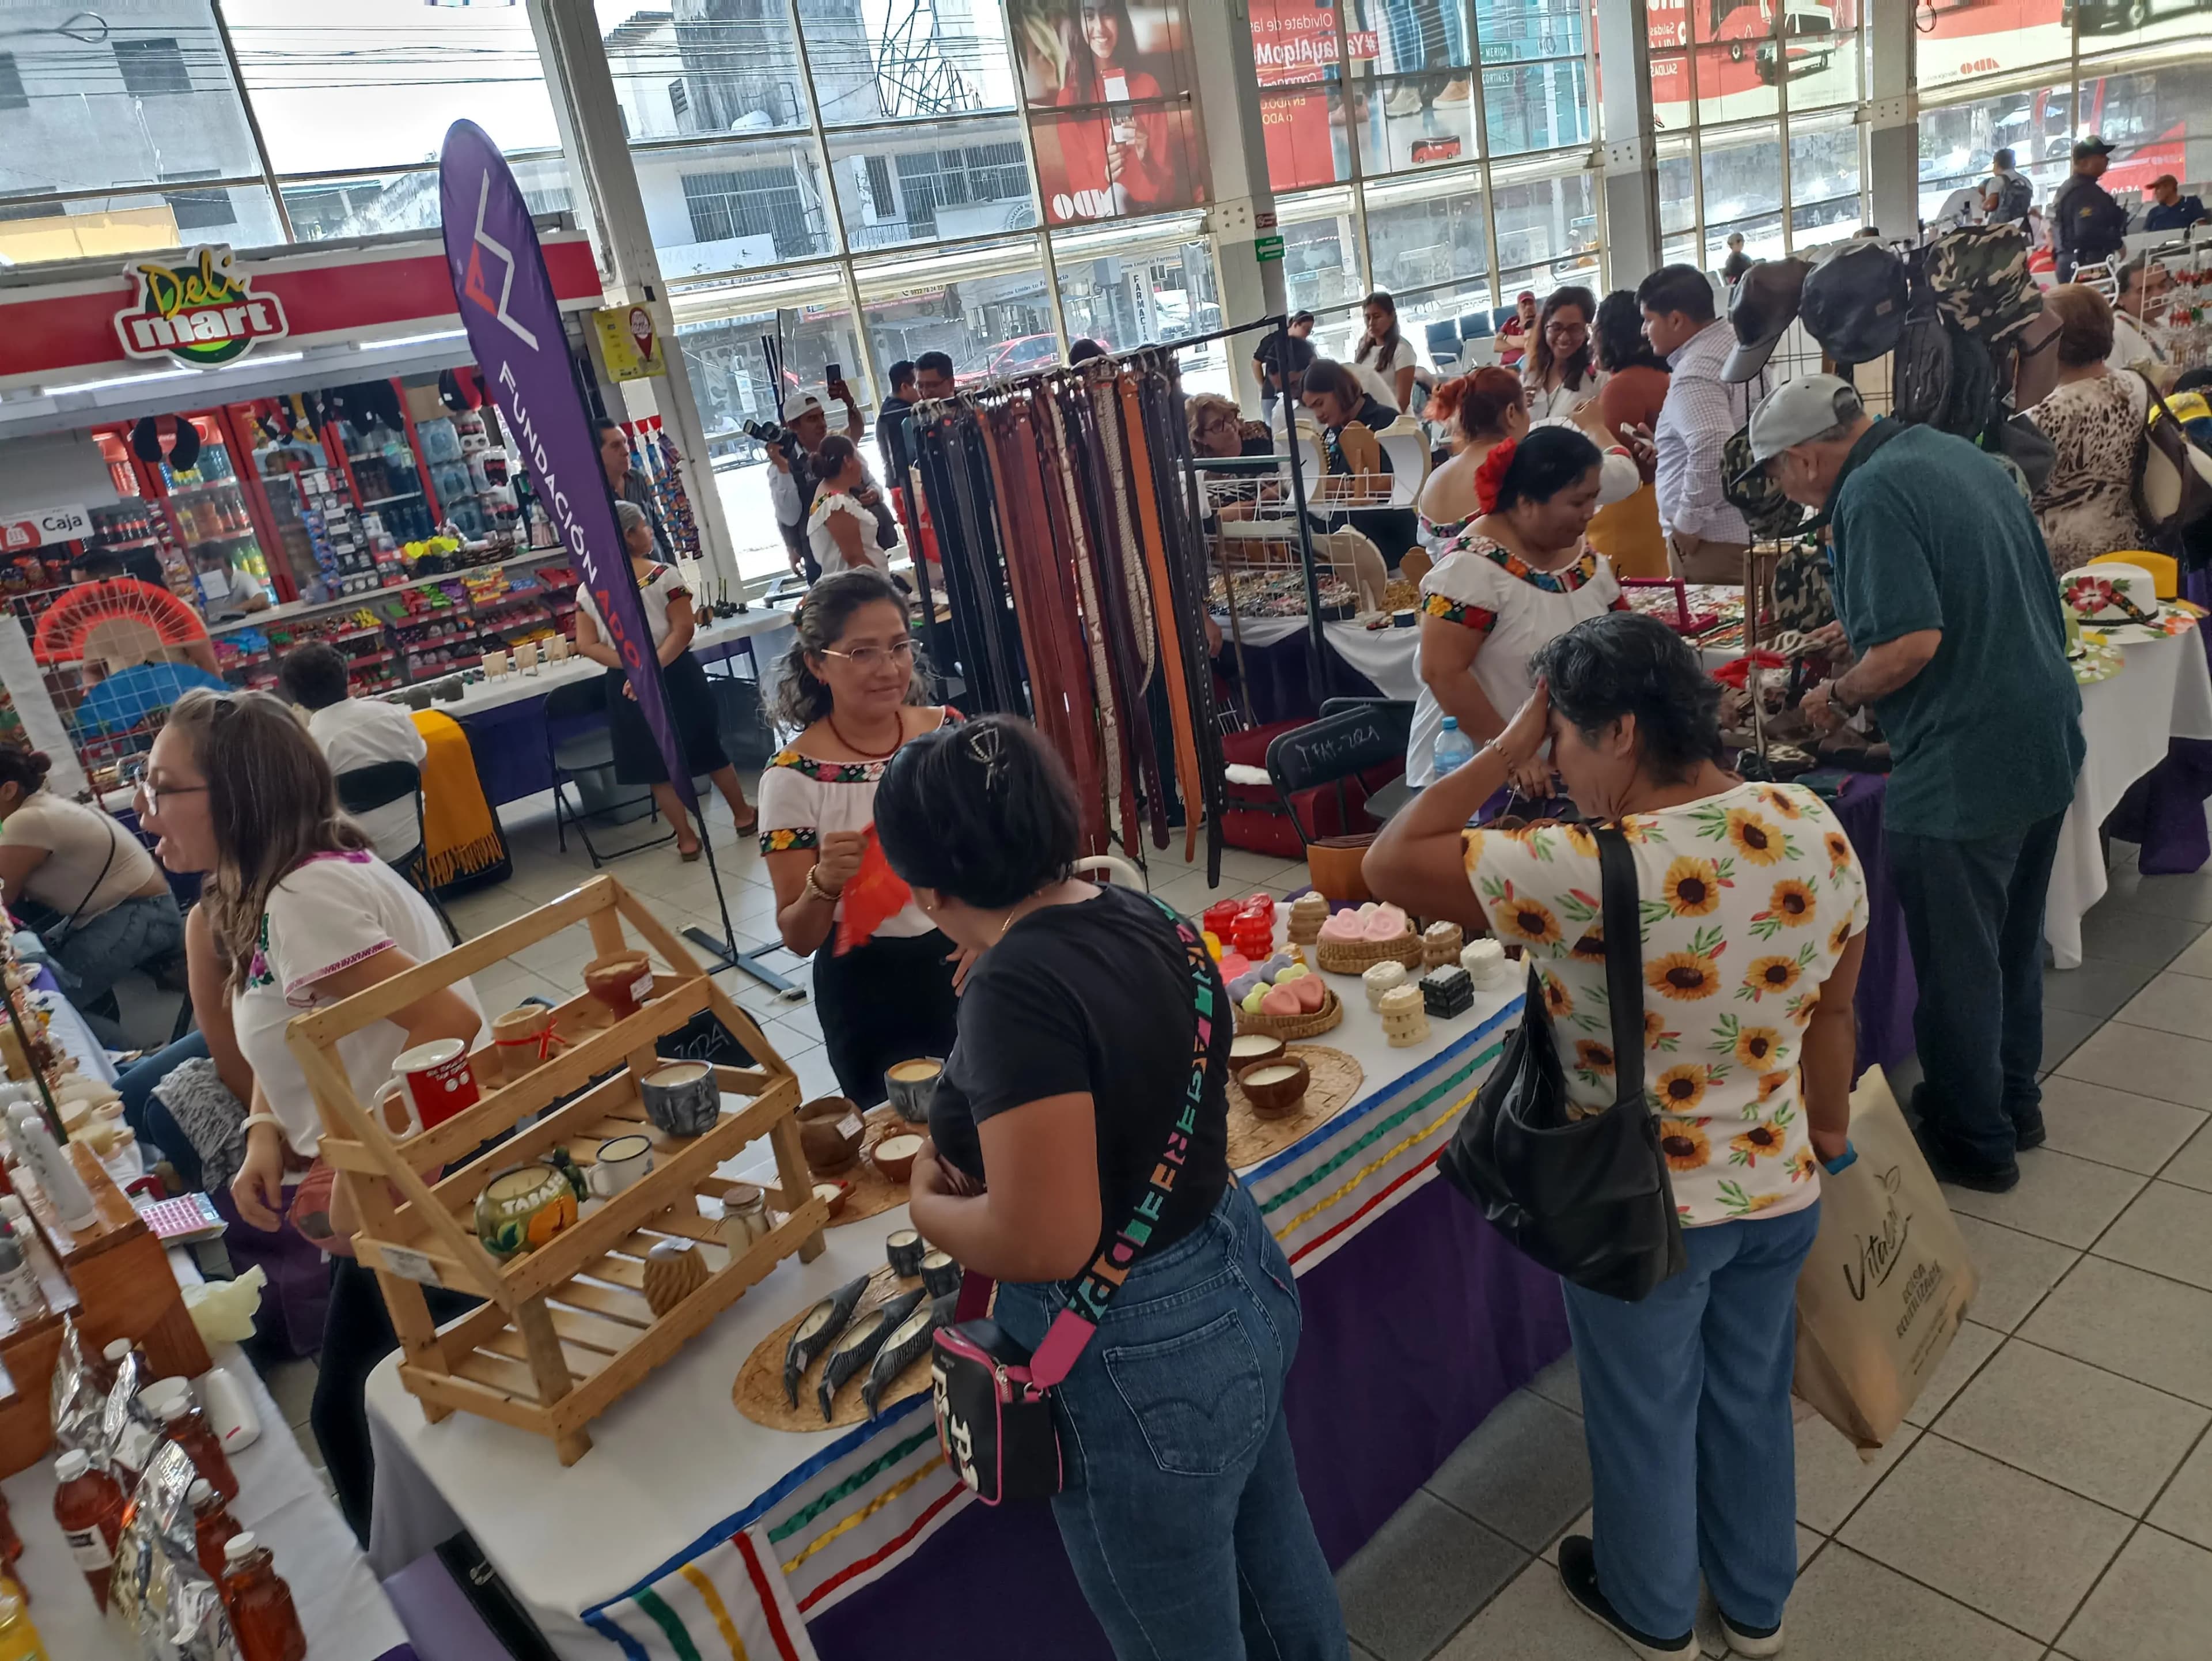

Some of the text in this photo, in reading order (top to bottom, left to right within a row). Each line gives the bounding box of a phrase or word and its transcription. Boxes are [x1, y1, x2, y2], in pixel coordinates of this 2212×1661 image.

[1486, 47, 1507, 56] MERIDA
[1482, 73, 1509, 85] CORTINES
[138, 249, 245, 321] Deli
[1133, 275, 1149, 342] FARMACIA
[131, 302, 273, 349] mart
[498, 360, 598, 584] FUNDACIÓN
[42, 514, 83, 531] Caja
